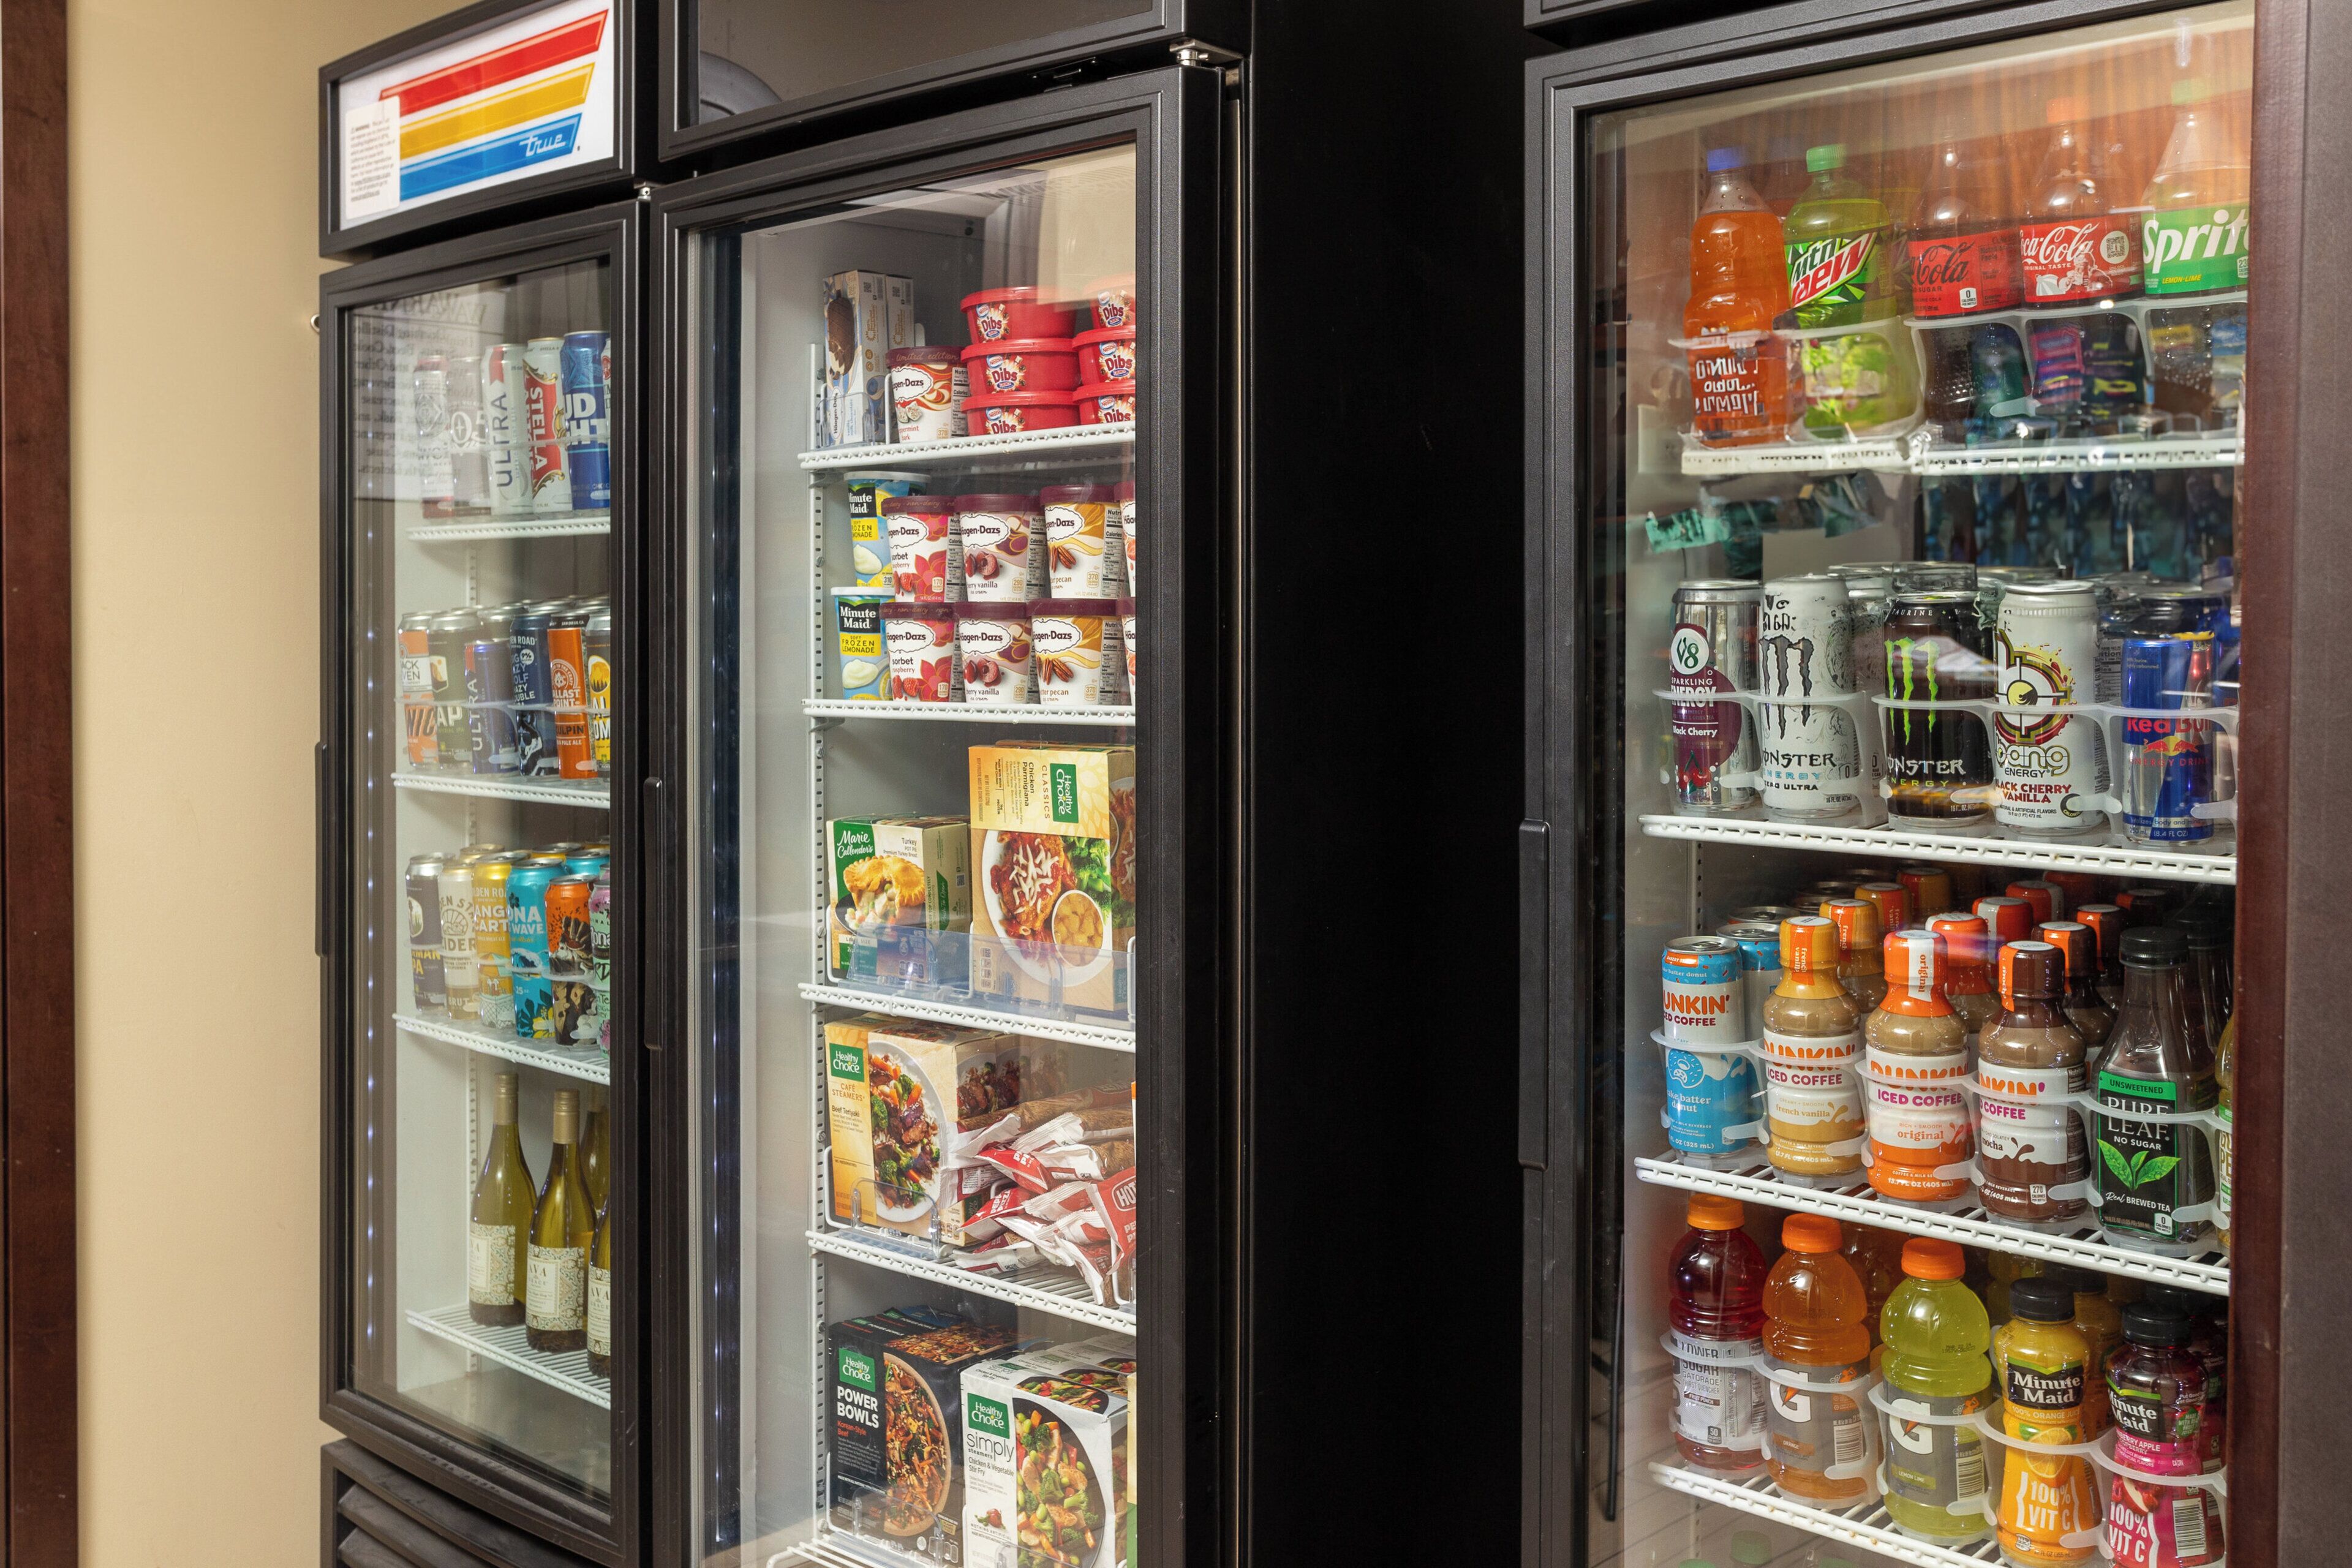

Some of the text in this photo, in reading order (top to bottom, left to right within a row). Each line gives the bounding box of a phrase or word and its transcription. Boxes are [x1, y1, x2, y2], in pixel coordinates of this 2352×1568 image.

[519, 134, 566, 157] true
[2162, 274, 2202, 284] LEMON-LIME
[1102, 303, 1124, 320] Dibs
[981, 316, 1002, 331] Dibs
[896, 352, 959, 361] limited edition
[1104, 355, 1133, 371] Dibs
[992, 368, 1018, 382] Dibs
[565, 392, 597, 419] UD
[1104, 409, 1131, 423] Dibs
[530, 387, 548, 470] STELLA
[991, 420, 1017, 434] Dibs
[491, 393, 512, 487] ULTRA
[840, 606, 876, 617] Minute
[844, 617, 870, 628] Maid
[518, 636, 535, 646] ROAD
[1676, 637, 1700, 668] V8
[1671, 677, 1713, 685] SPARKLING
[467, 679, 483, 751] ULTRA
[1687, 727, 1717, 737] Cherry
[1996, 738, 2070, 777] bang
[2005, 767, 2046, 778] ENERGY
[1041, 765, 1050, 819] CLASSICS
[1056, 769, 1066, 815] Choice
[2021, 783, 2071, 794] CHERRY
[2002, 790, 2051, 804] VANILLA
[2154, 817, 2171, 826] body
[837, 830, 870, 846] Marie
[837, 845, 873, 859] Callender's
[511, 924, 544, 934] WAVE
[1918, 954, 1926, 993] original
[1674, 1015, 1716, 1026] COFFEE
[835, 1050, 859, 1065] Healthy
[833, 1059, 860, 1073] Choice
[1767, 1067, 1842, 1085] ICED COFFEE
[840, 1083, 855, 1092] CAFÉ
[2109, 1079, 2163, 1095] UNSWEETENED
[832, 1090, 863, 1101] STEAMERS
[1679, 1093, 1711, 1104] batter
[1877, 1088, 1962, 1107] ICED COFFEE
[843, 1107, 860, 1117] Teriyaki
[1672, 1100, 1697, 1112] donut
[1776, 1103, 1800, 1116] french
[1984, 1101, 2026, 1120] COFFEE
[2107, 1096, 2169, 1116] PURE
[1897, 1129, 1944, 1141] original
[2108, 1116, 2167, 1140] LEAF
[1982, 1137, 2003, 1152] mocha
[2114, 1135, 2162, 1151] NO SUGAR
[2105, 1191, 2171, 1213] Real BREWED TEA
[846, 1356, 869, 1373] Healthy
[842, 1365, 870, 1382] Choice
[1682, 1371, 1719, 1386] GATORADE
[2013, 1370, 2081, 1390] Minute
[1698, 1384, 1720, 1394] QUENCHER
[1770, 1369, 1811, 1423] G
[2023, 1388, 2074, 1405] Maid
[837, 1385, 878, 1412] POWER
[1700, 1396, 1714, 1404] PUNCH
[837, 1401, 879, 1428] BOWLS
[975, 1401, 1002, 1419] Healthy
[2012, 1406, 2065, 1420] 100% ORANGE
[971, 1411, 1005, 1429] Choice
[1889, 1398, 1934, 1454] G
[2112, 1405, 2151, 1433] Maid
[837, 1420, 867, 1436] Korean-Style
[837, 1428, 848, 1437] Beef
[967, 1432, 1014, 1462] simply
[1783, 1439, 1800, 1449] ORANGE
[2139, 1441, 2161, 1452] APPLE
[968, 1449, 993, 1459] steamers
[968, 1457, 1014, 1477] Chicken Vegetable
[1899, 1470, 1913, 1480] LEMON
[2030, 1480, 2070, 1506] 100%
[2029, 1504, 2071, 1531] VIT C
[2109, 1500, 2147, 1538] 100%
[2108, 1523, 2146, 1564] VIT C
